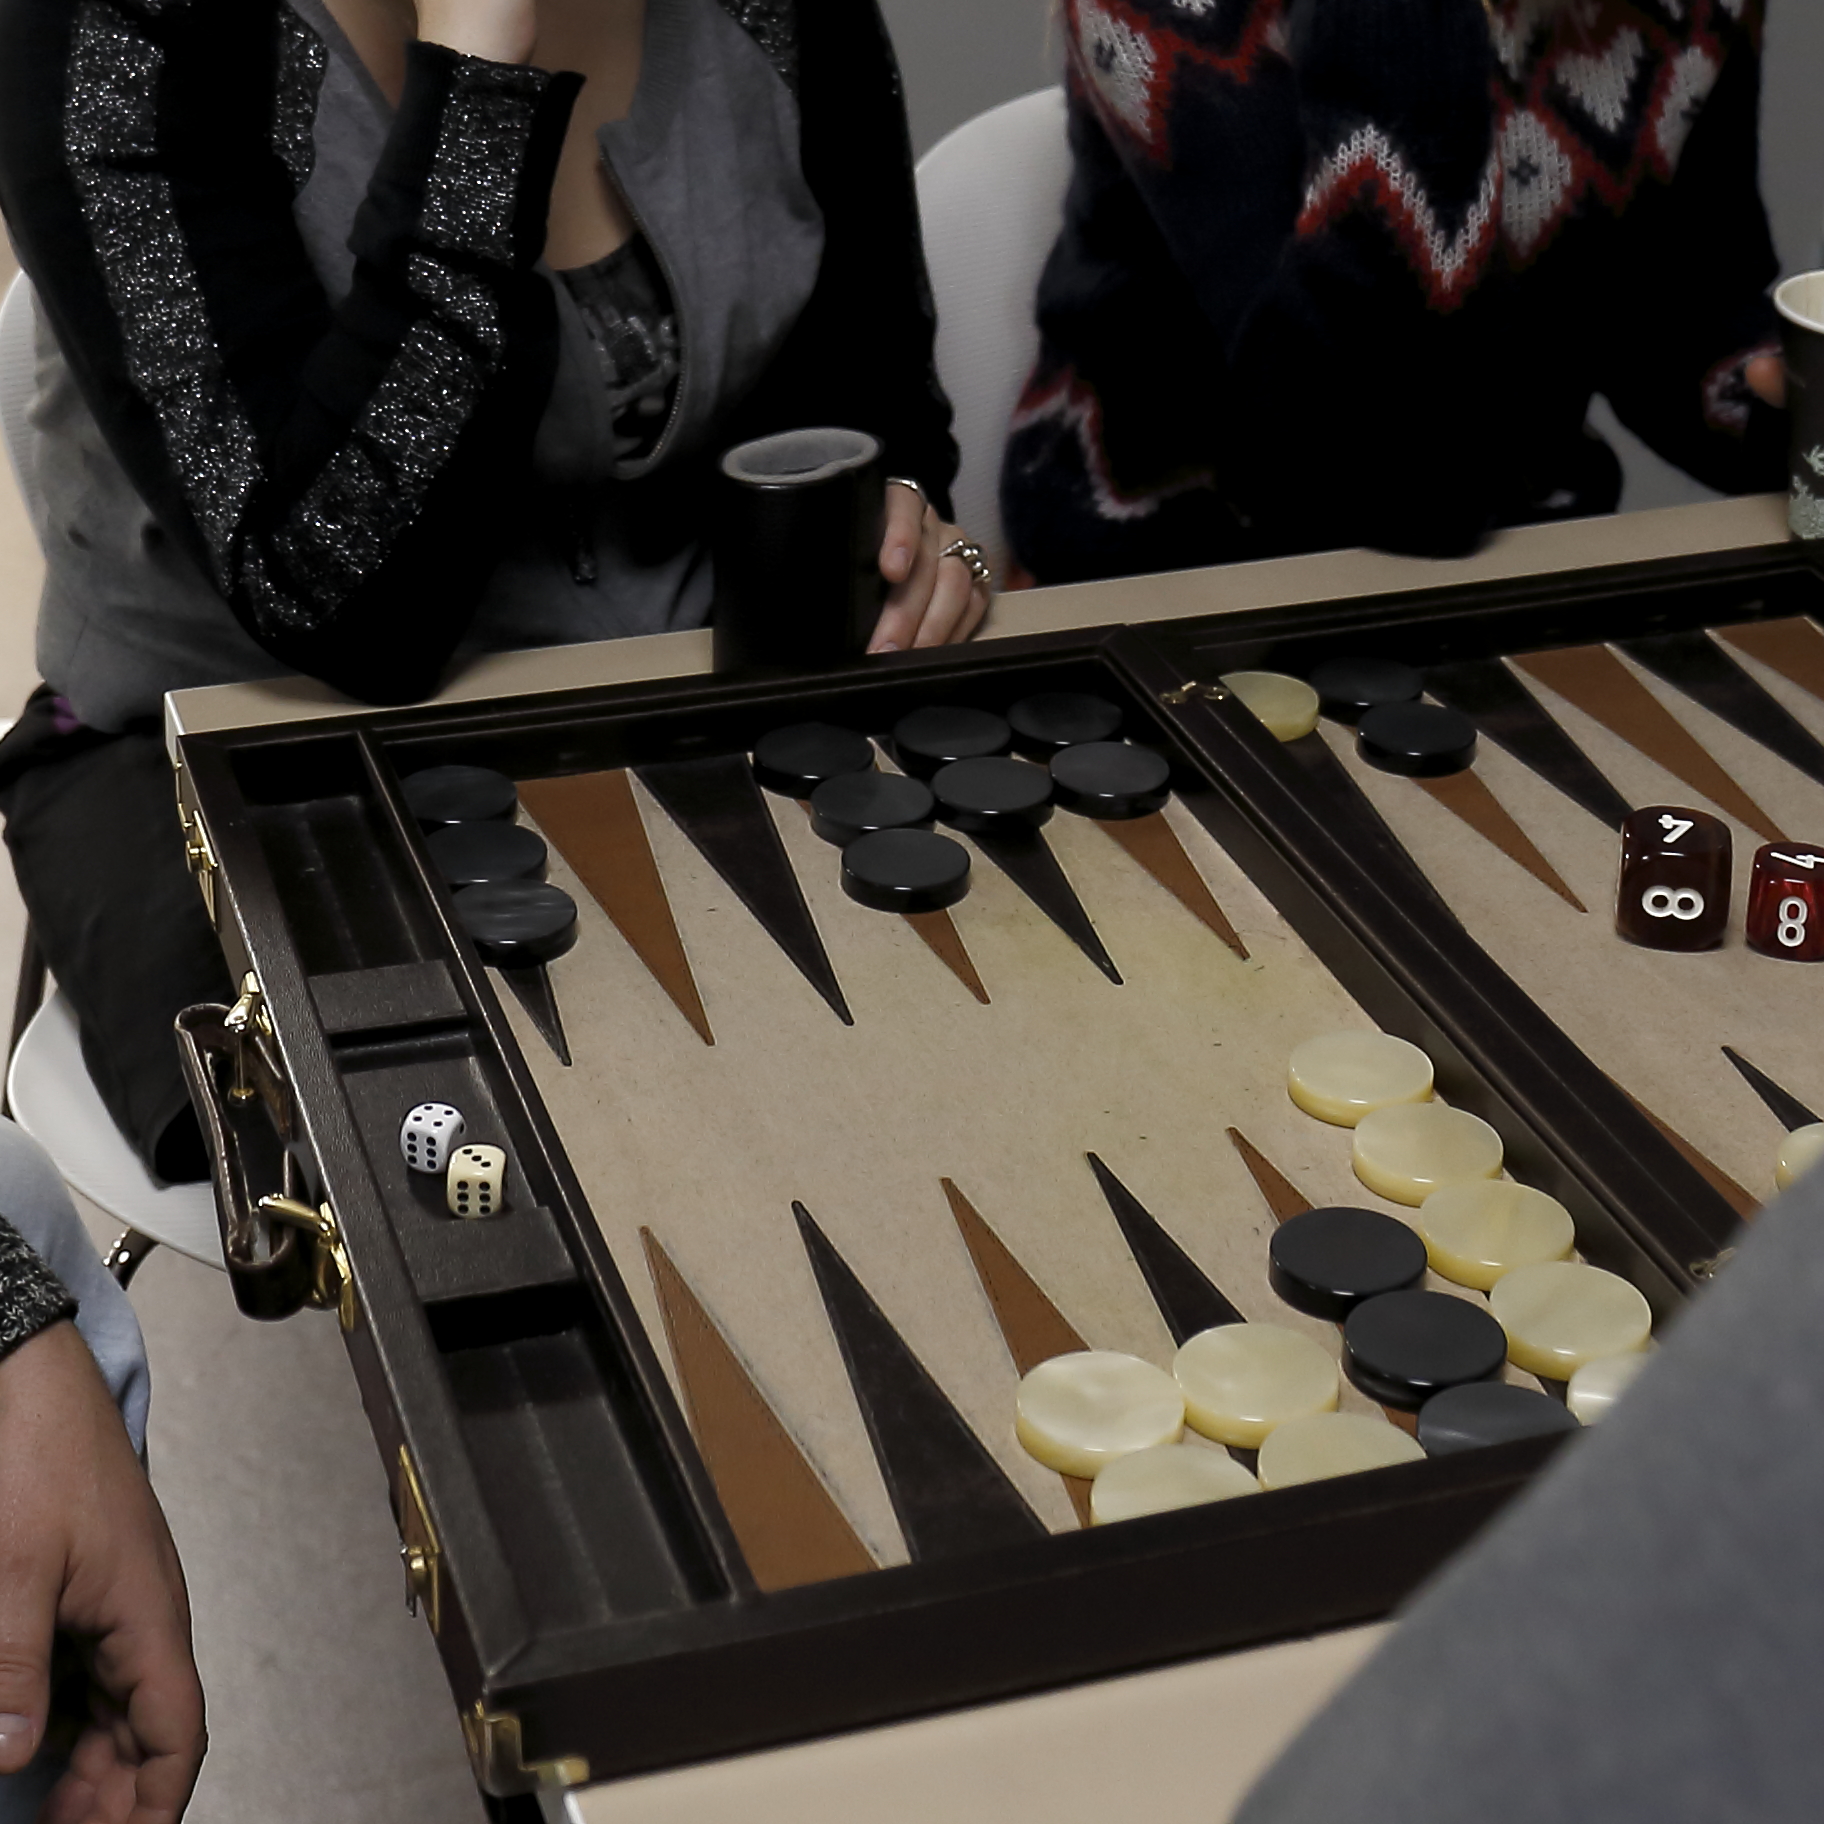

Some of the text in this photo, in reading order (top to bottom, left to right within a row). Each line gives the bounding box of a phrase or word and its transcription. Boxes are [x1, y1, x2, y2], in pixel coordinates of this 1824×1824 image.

[1657, 813, 1694, 844] 4
[1641, 884, 1706, 920] 8
[1776, 896, 1809, 947] 8
